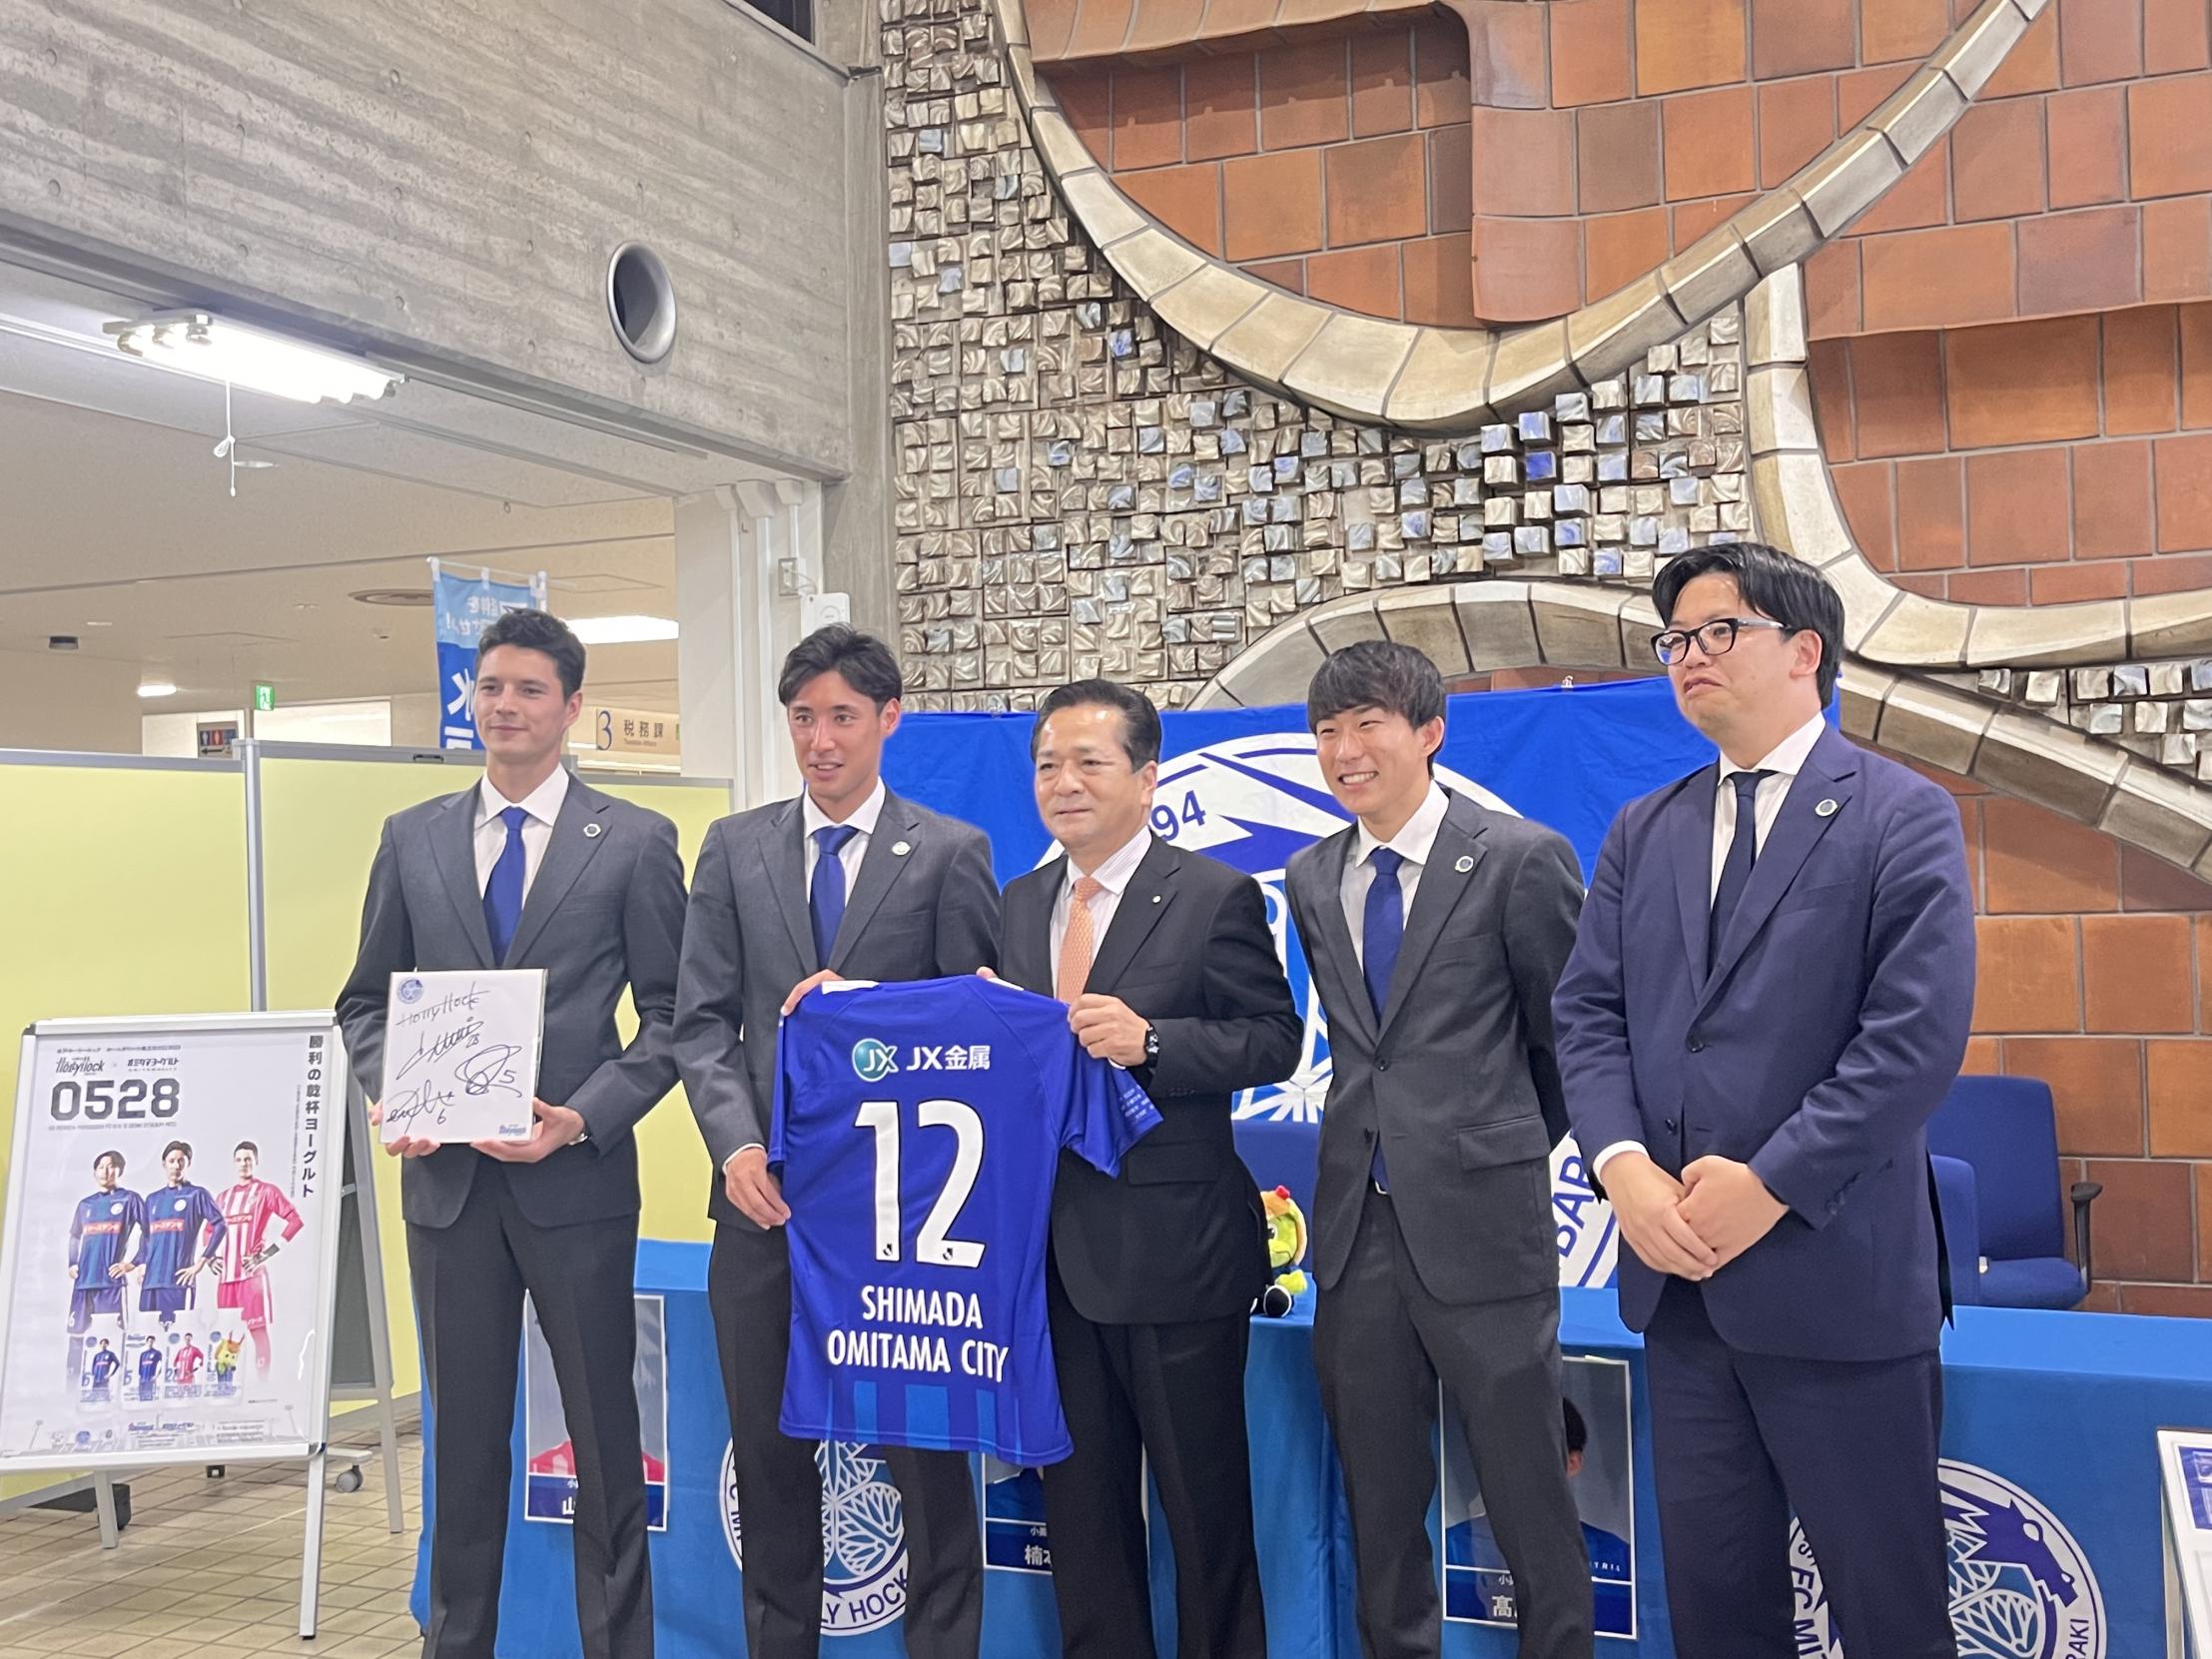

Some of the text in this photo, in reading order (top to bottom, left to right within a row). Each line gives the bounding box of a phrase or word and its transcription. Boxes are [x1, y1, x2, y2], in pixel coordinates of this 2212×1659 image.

[598, 710, 612, 751] 3
[623, 719, 664, 738] 税務課
[50, 1078, 181, 1121] 0528
[302, 1035, 324, 1199] 勝利の乾杯ヨーグルト
[437, 1109, 447, 1125] 6
[854, 1100, 987, 1268] 12
[861, 1284, 984, 1329] SHIMADA
[827, 1329, 1010, 1382] OMITAMA CITY
